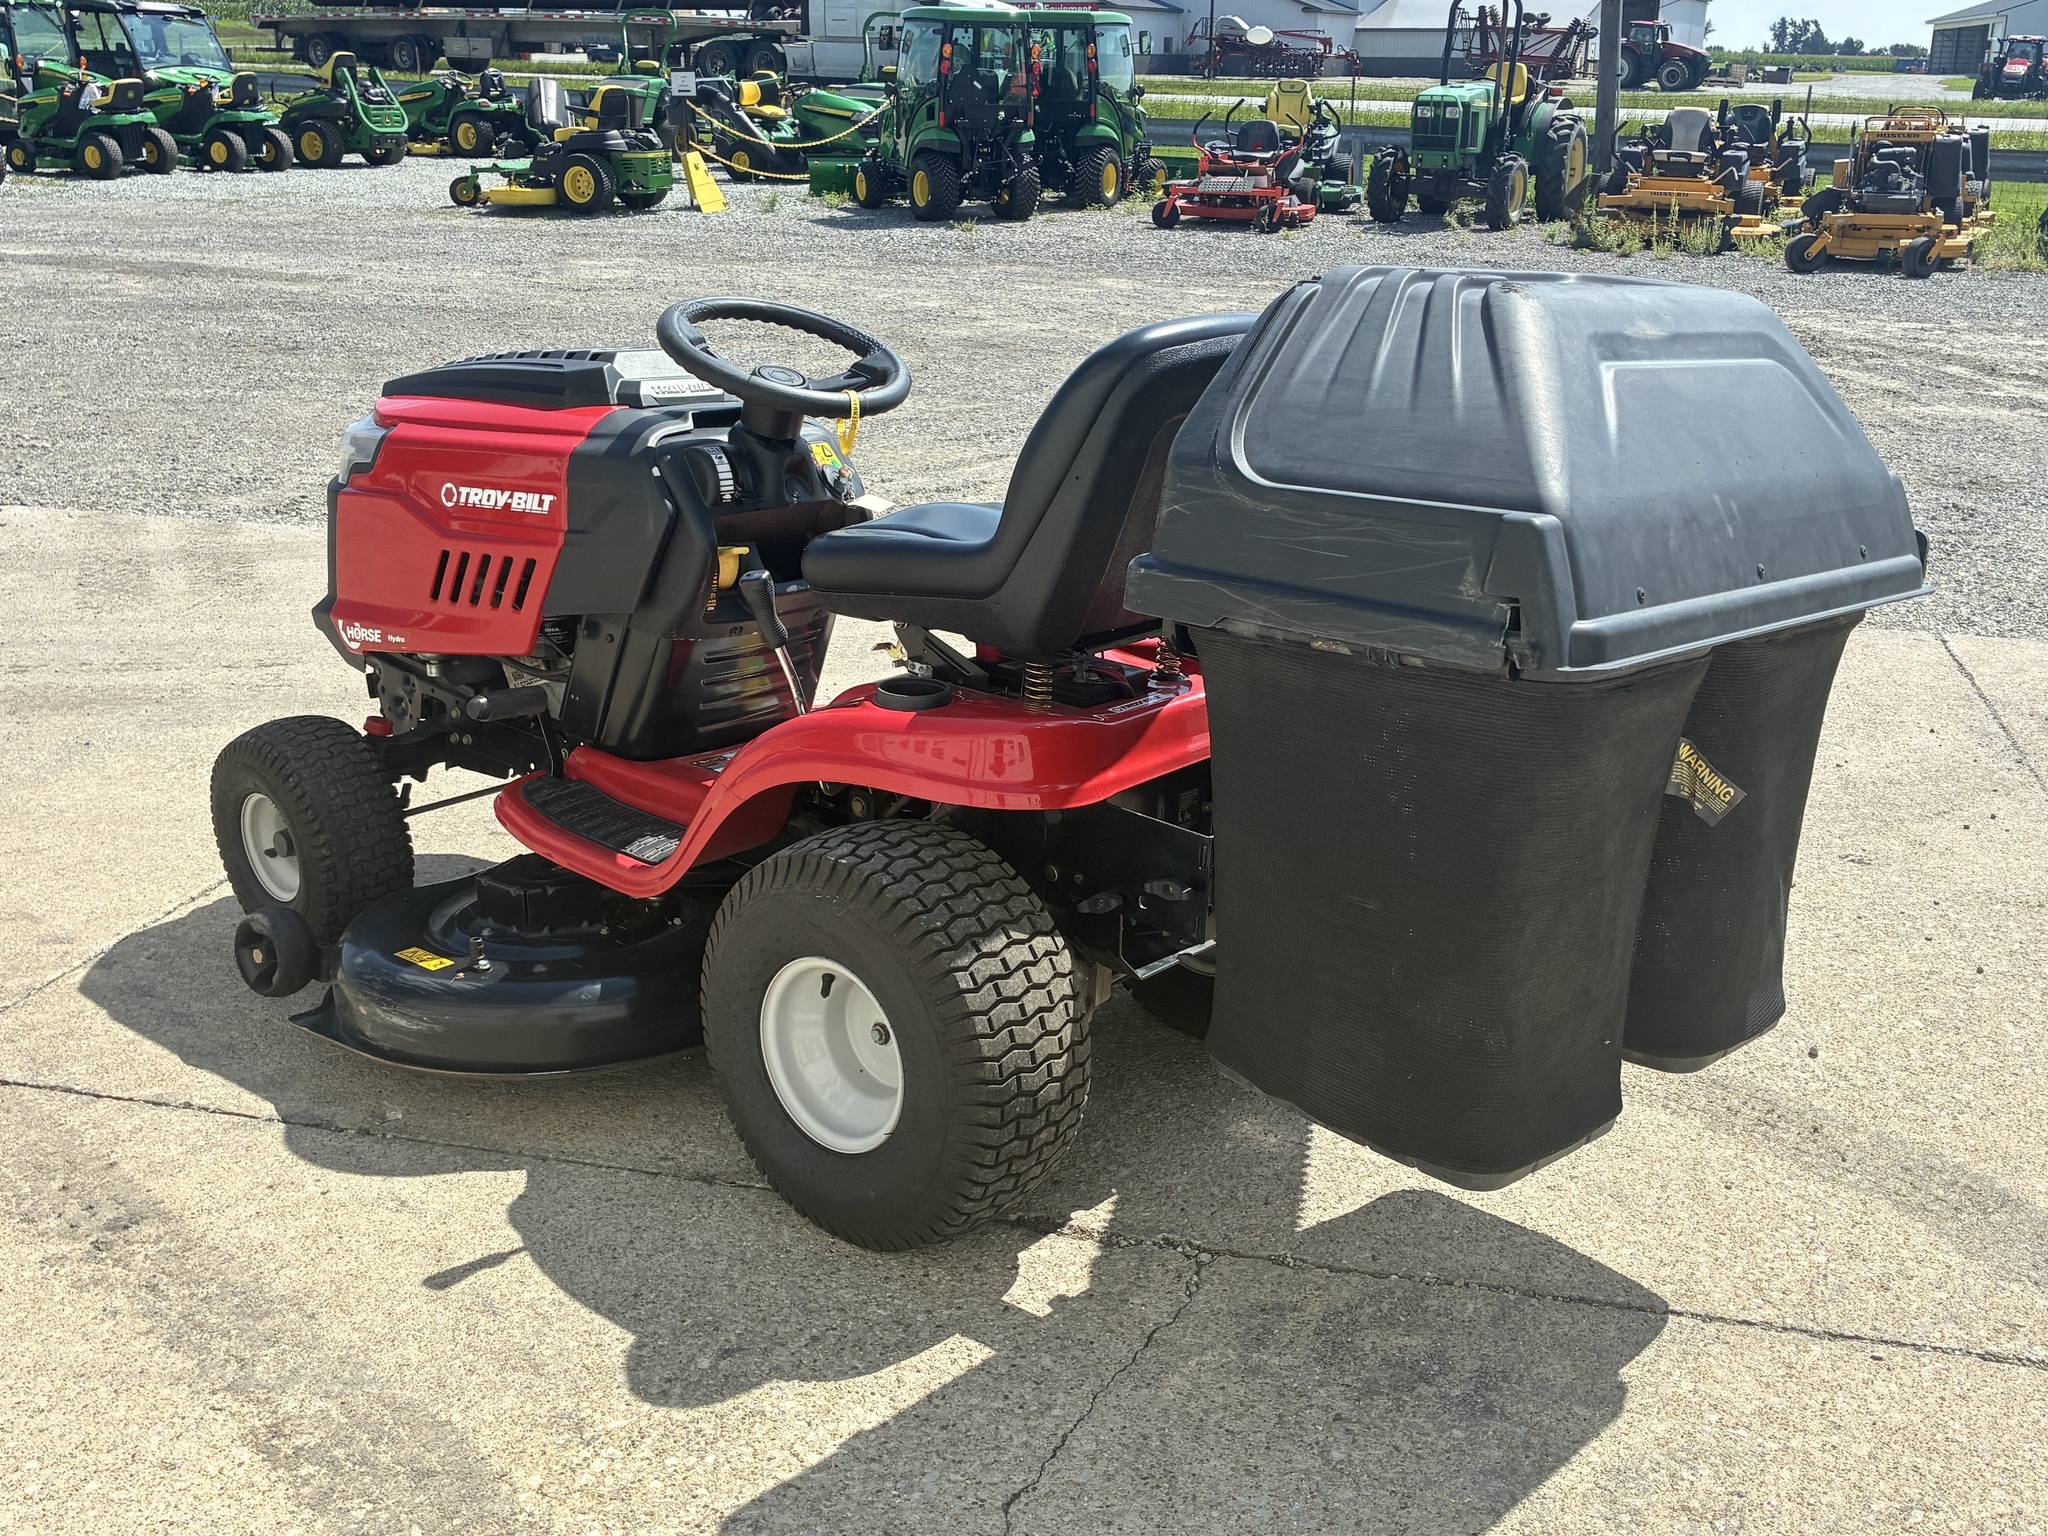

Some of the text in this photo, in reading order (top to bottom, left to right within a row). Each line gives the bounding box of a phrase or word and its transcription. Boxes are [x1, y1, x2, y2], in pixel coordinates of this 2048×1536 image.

[458, 486, 554, 515] TROY-BILT
[346, 624, 406, 643] HORSE Hydro
[1678, 742, 1735, 803] WARNING
